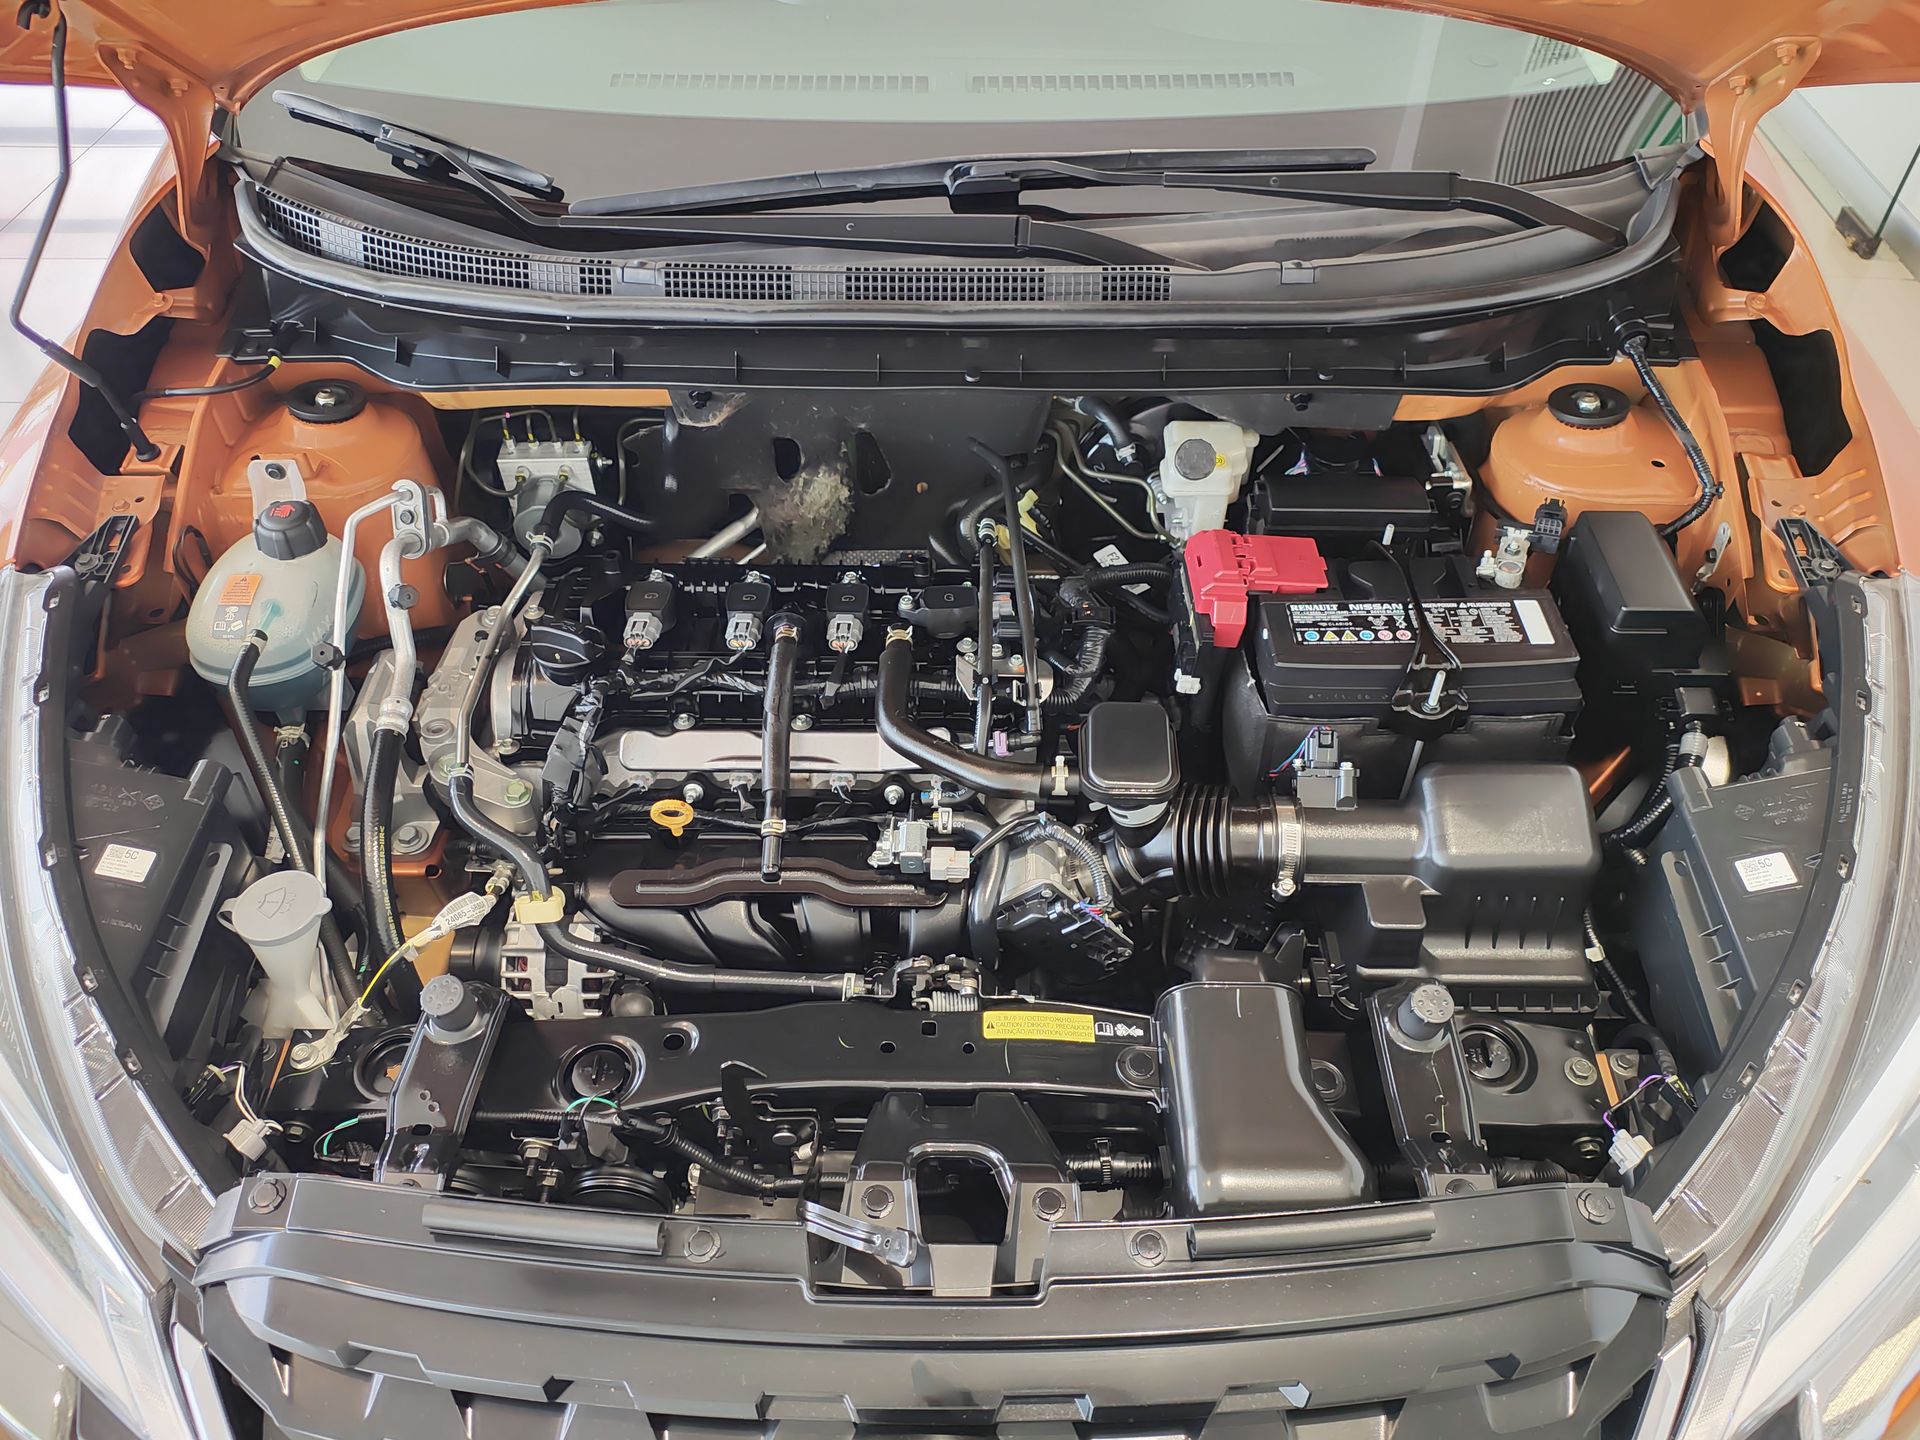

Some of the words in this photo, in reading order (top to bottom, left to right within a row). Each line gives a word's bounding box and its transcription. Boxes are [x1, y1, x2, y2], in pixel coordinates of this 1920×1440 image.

[1348, 603, 1403, 611] NISSAN
[124, 849, 139, 860] 5C
[1757, 857, 1773, 869] 5C
